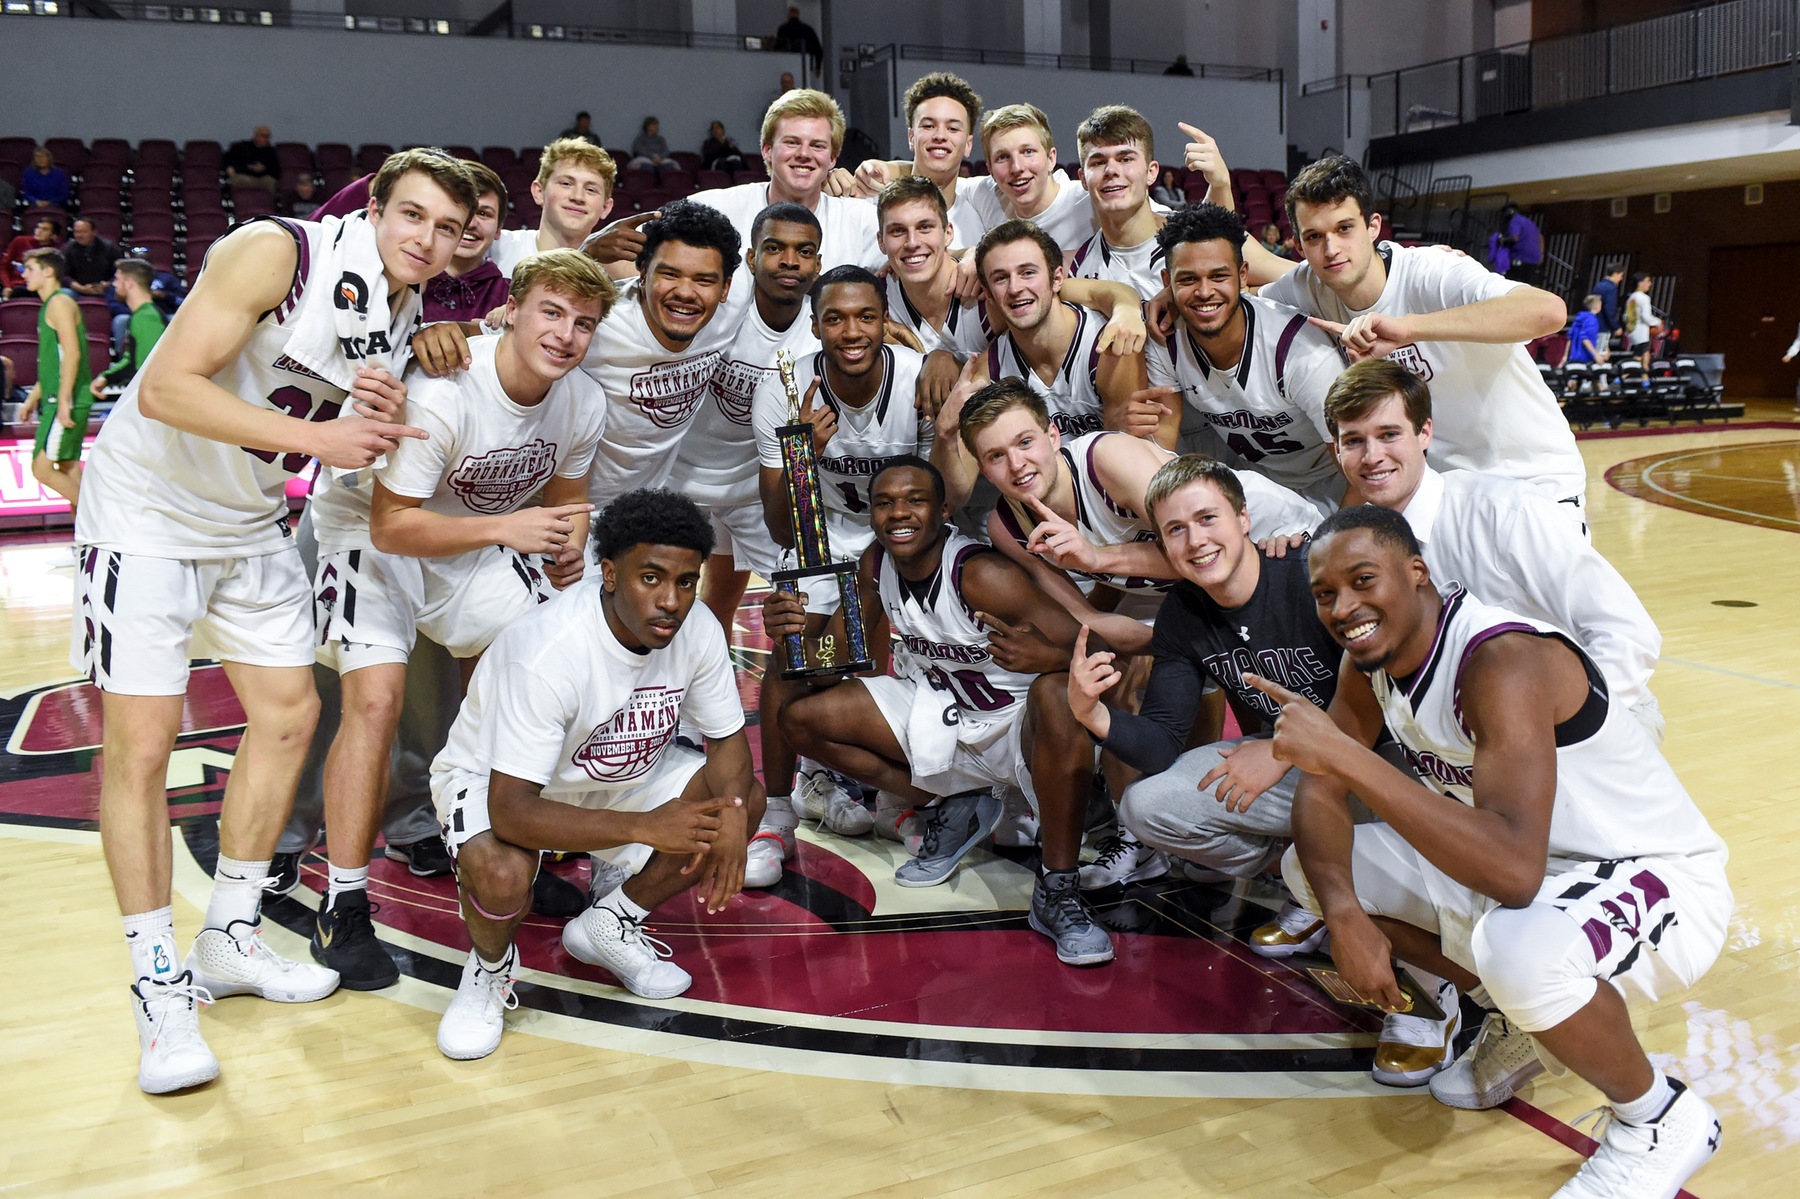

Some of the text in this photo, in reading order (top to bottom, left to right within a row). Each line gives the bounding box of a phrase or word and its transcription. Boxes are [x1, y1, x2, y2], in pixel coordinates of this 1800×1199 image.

[1388, 349, 1413, 359] WICH
[636, 363, 715, 398] TOURNAMENT
[711, 367, 758, 396] TOURN
[739, 372, 759, 382] DICK
[1226, 431, 1305, 462] 45
[818, 455, 891, 476] MAROO
[835, 481, 871, 514] 1
[818, 634, 836, 652] 19
[931, 664, 1015, 711] 10
[630, 695, 681, 710] LEFTWICH
[603, 703, 681, 735] NAMEN
[590, 741, 636, 757] NOVEMBER
